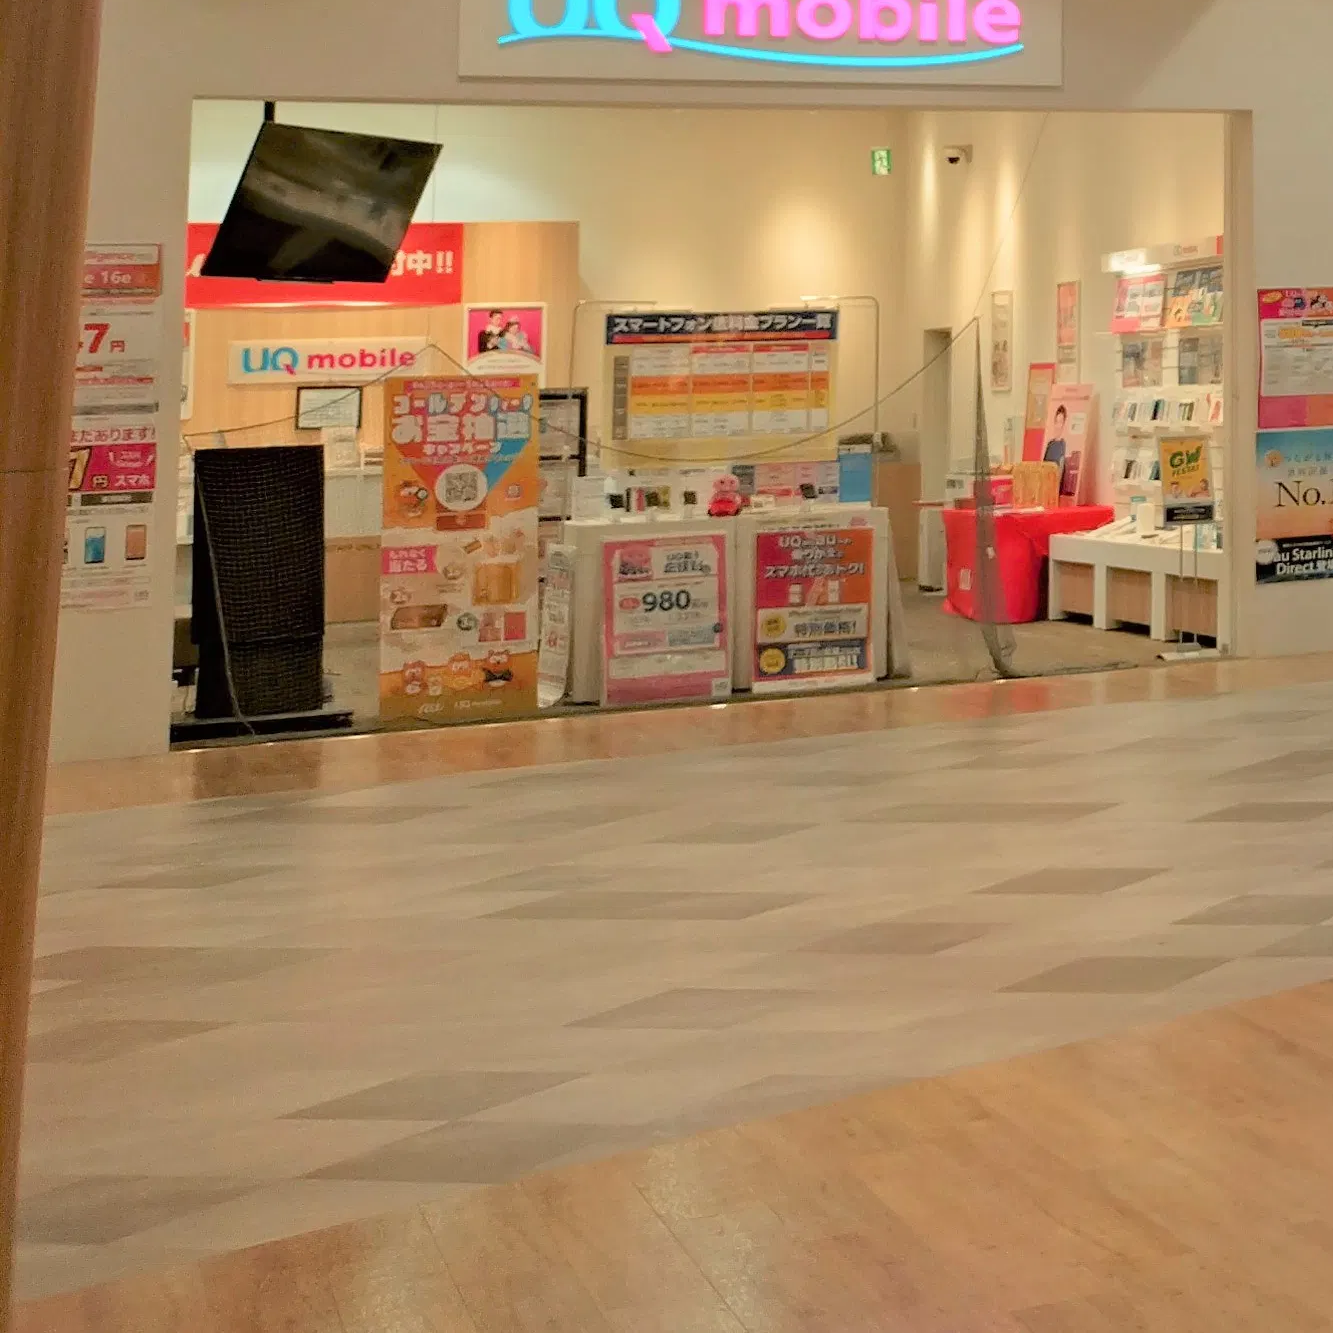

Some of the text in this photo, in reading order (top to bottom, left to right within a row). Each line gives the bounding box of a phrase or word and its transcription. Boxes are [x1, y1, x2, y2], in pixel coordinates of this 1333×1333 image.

[241, 347, 416, 375] UQ mobile
[1276, 561, 1315, 576] Direct
[641, 589, 691, 613] 980
